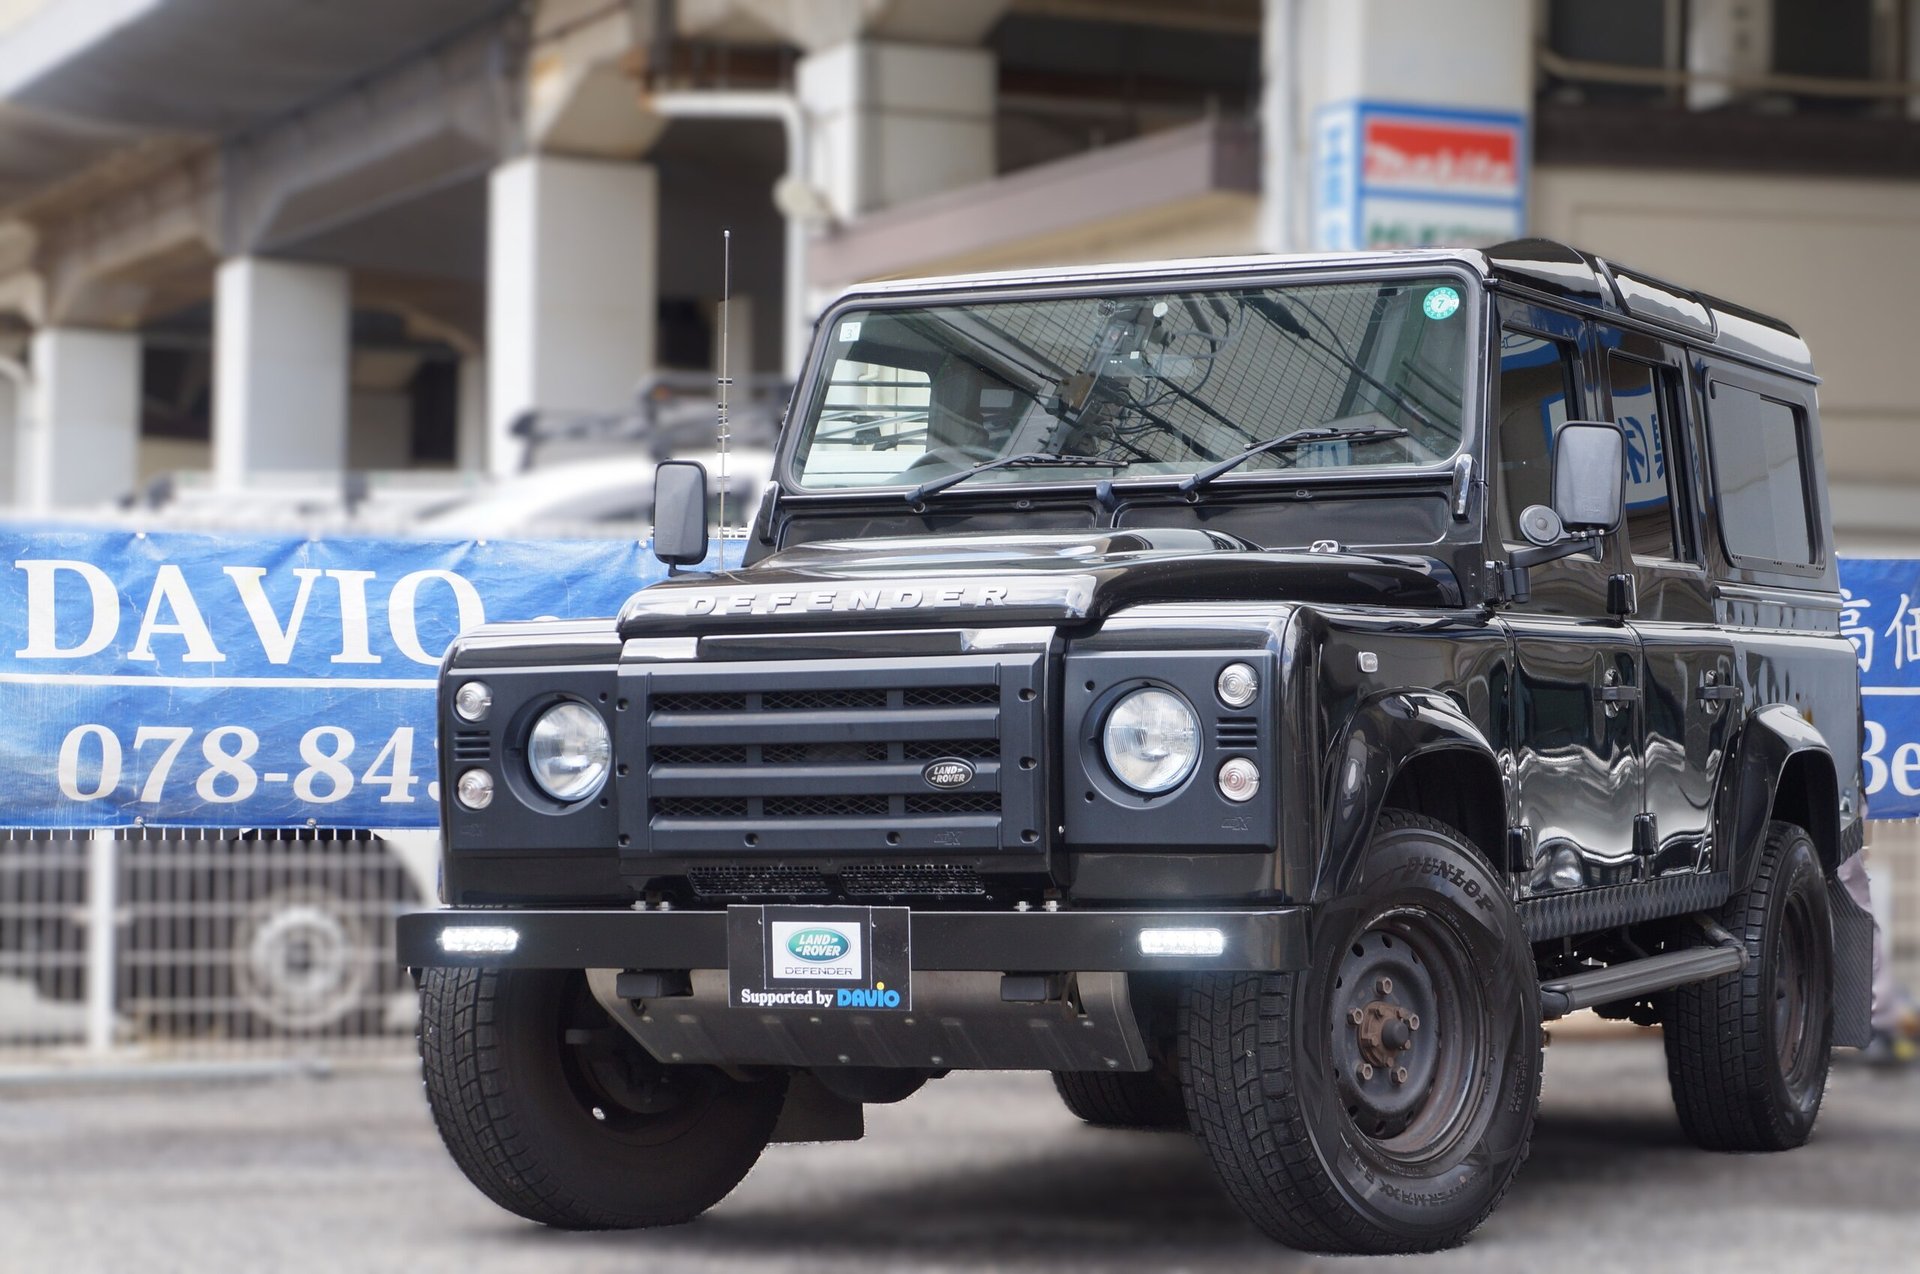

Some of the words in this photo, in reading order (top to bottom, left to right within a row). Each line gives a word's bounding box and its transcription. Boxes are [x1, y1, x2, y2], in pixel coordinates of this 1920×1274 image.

[686, 585, 1009, 616] DEFENDER
[14, 558, 486, 665] DAVIO
[57, 723, 439, 803] 078-84
[933, 766, 958, 775] LAND
[936, 774, 966, 783] ROVER
[1405, 856, 1496, 913] DUNLOP
[799, 933, 831, 945] LAND
[801, 944, 842, 956] ROVER
[784, 966, 853, 976] DEFENDER
[741, 988, 814, 1007] Supported
[816, 990, 834, 1008] by
